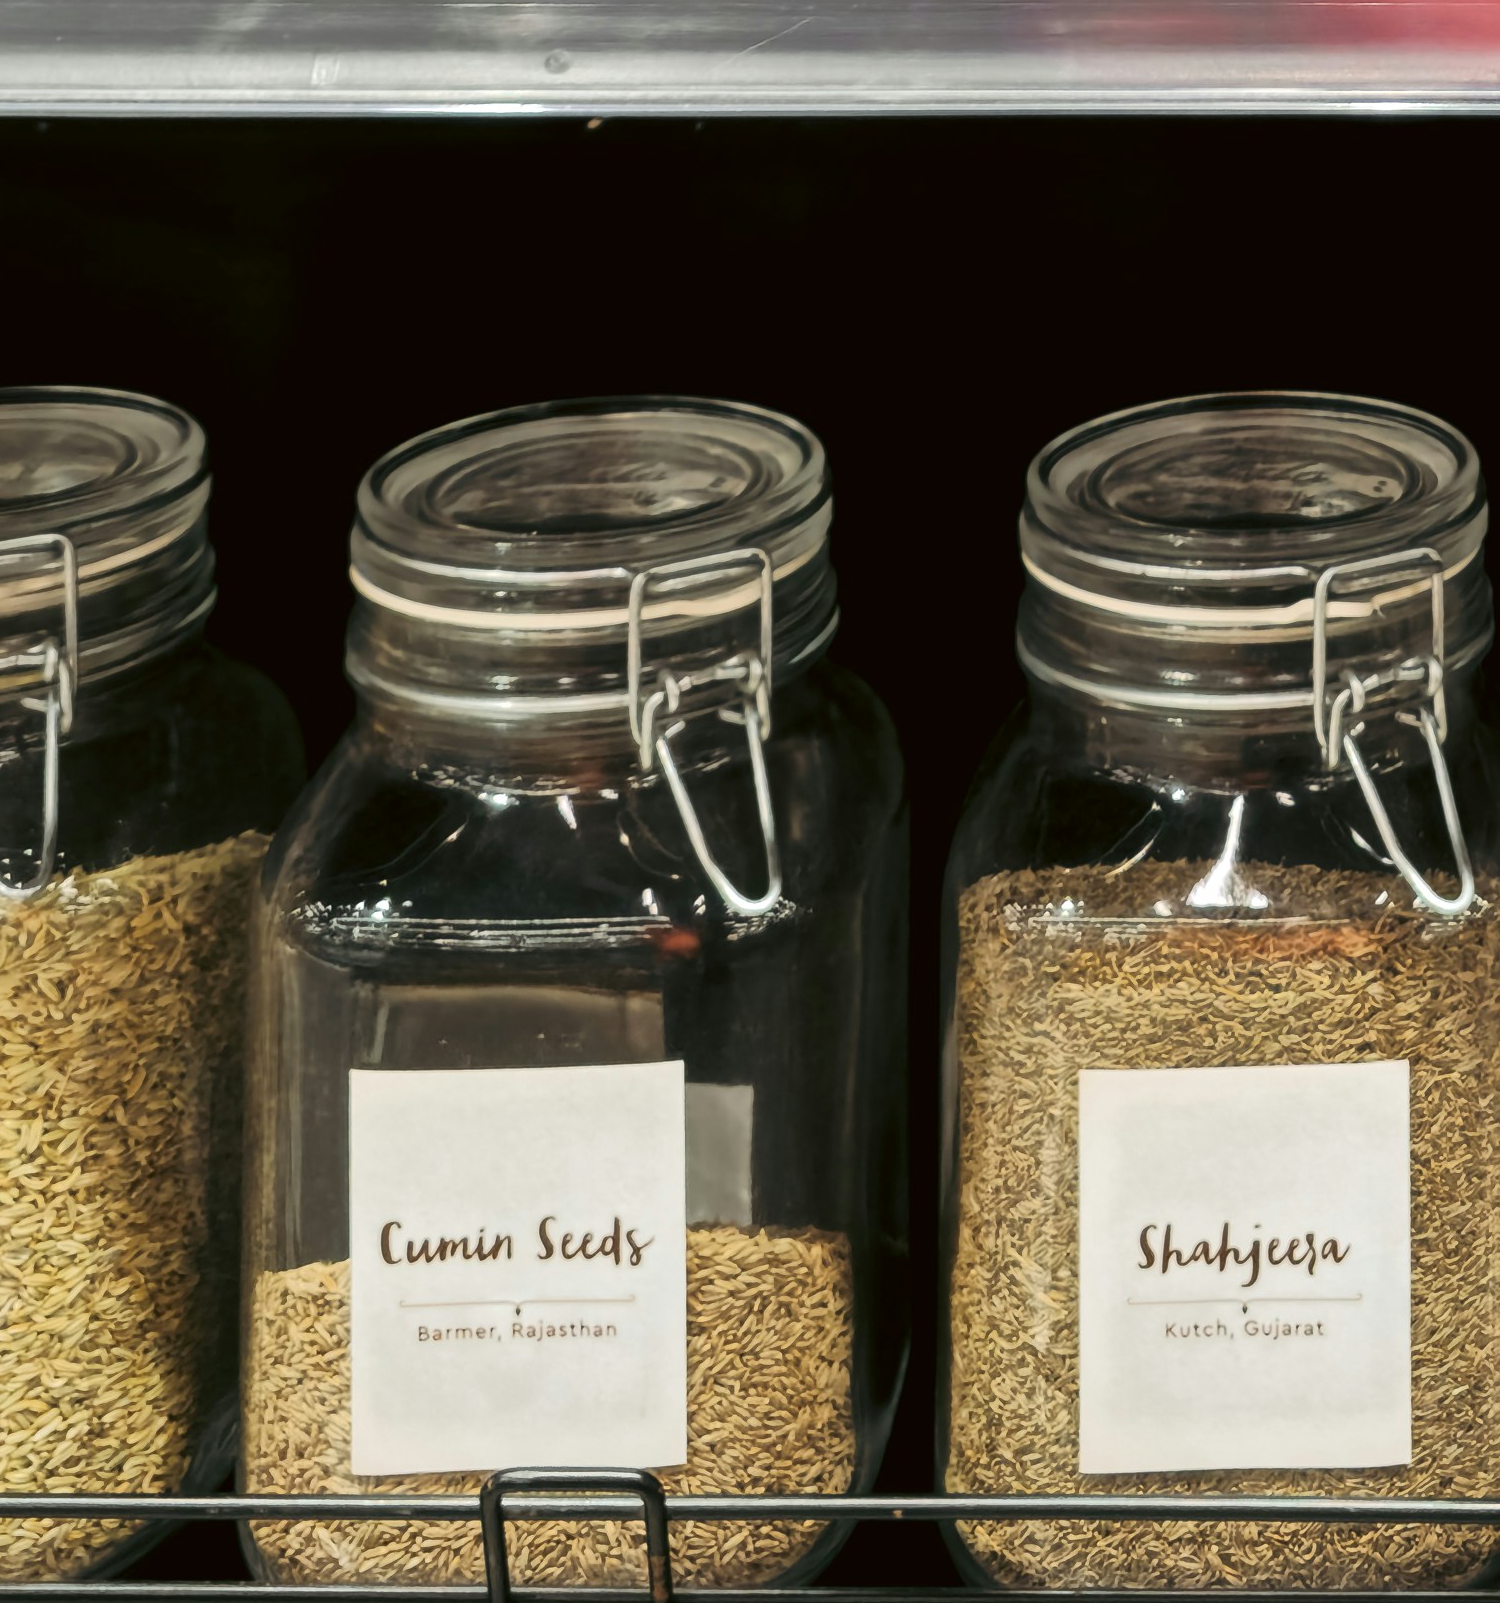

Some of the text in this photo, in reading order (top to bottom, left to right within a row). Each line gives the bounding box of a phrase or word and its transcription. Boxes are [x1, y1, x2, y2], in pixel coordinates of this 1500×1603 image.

[380, 1216, 654, 1266] Cumin Seeds
[1138, 1222, 1350, 1287] Shahjeera
[418, 1319, 617, 1342] Barmer, Rajasthan
[1165, 1318, 1324, 1341] Kutch, Gujarat
